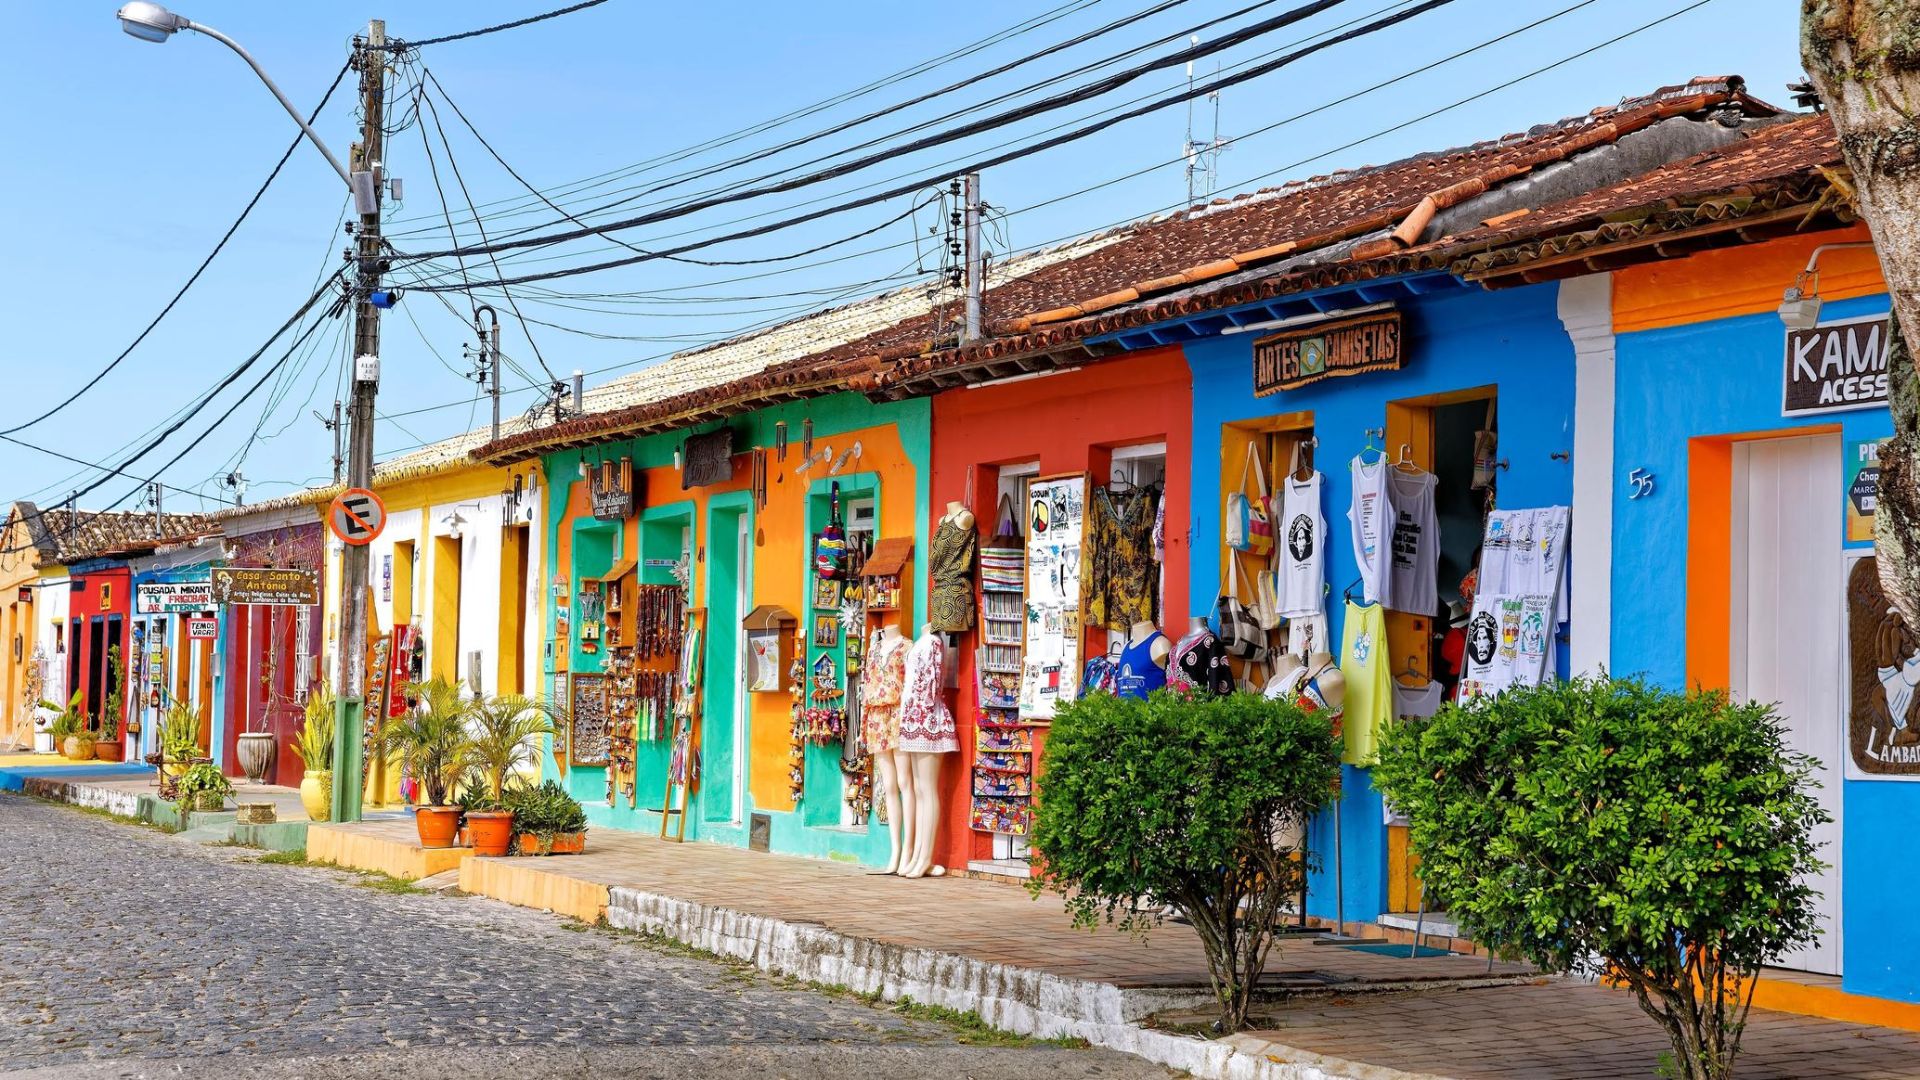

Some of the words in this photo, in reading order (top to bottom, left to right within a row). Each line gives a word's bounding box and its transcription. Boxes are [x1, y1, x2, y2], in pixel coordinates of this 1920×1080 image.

[1258, 341, 1300, 387] ARTES
[1325, 322, 1395, 367] CAMISETAS
[1628, 467, 1653, 499] 55
[1853, 486, 1876, 494] MARC
[343, 498, 374, 534] E
[236, 571, 260, 580] Casa
[269, 572, 300, 581] Santo
[138, 586, 176, 594] POUSADA
[168, 595, 209, 604] FRIGOBAR
[164, 604, 208, 612] INTERNET
[192, 622, 214, 630] TEMOS
